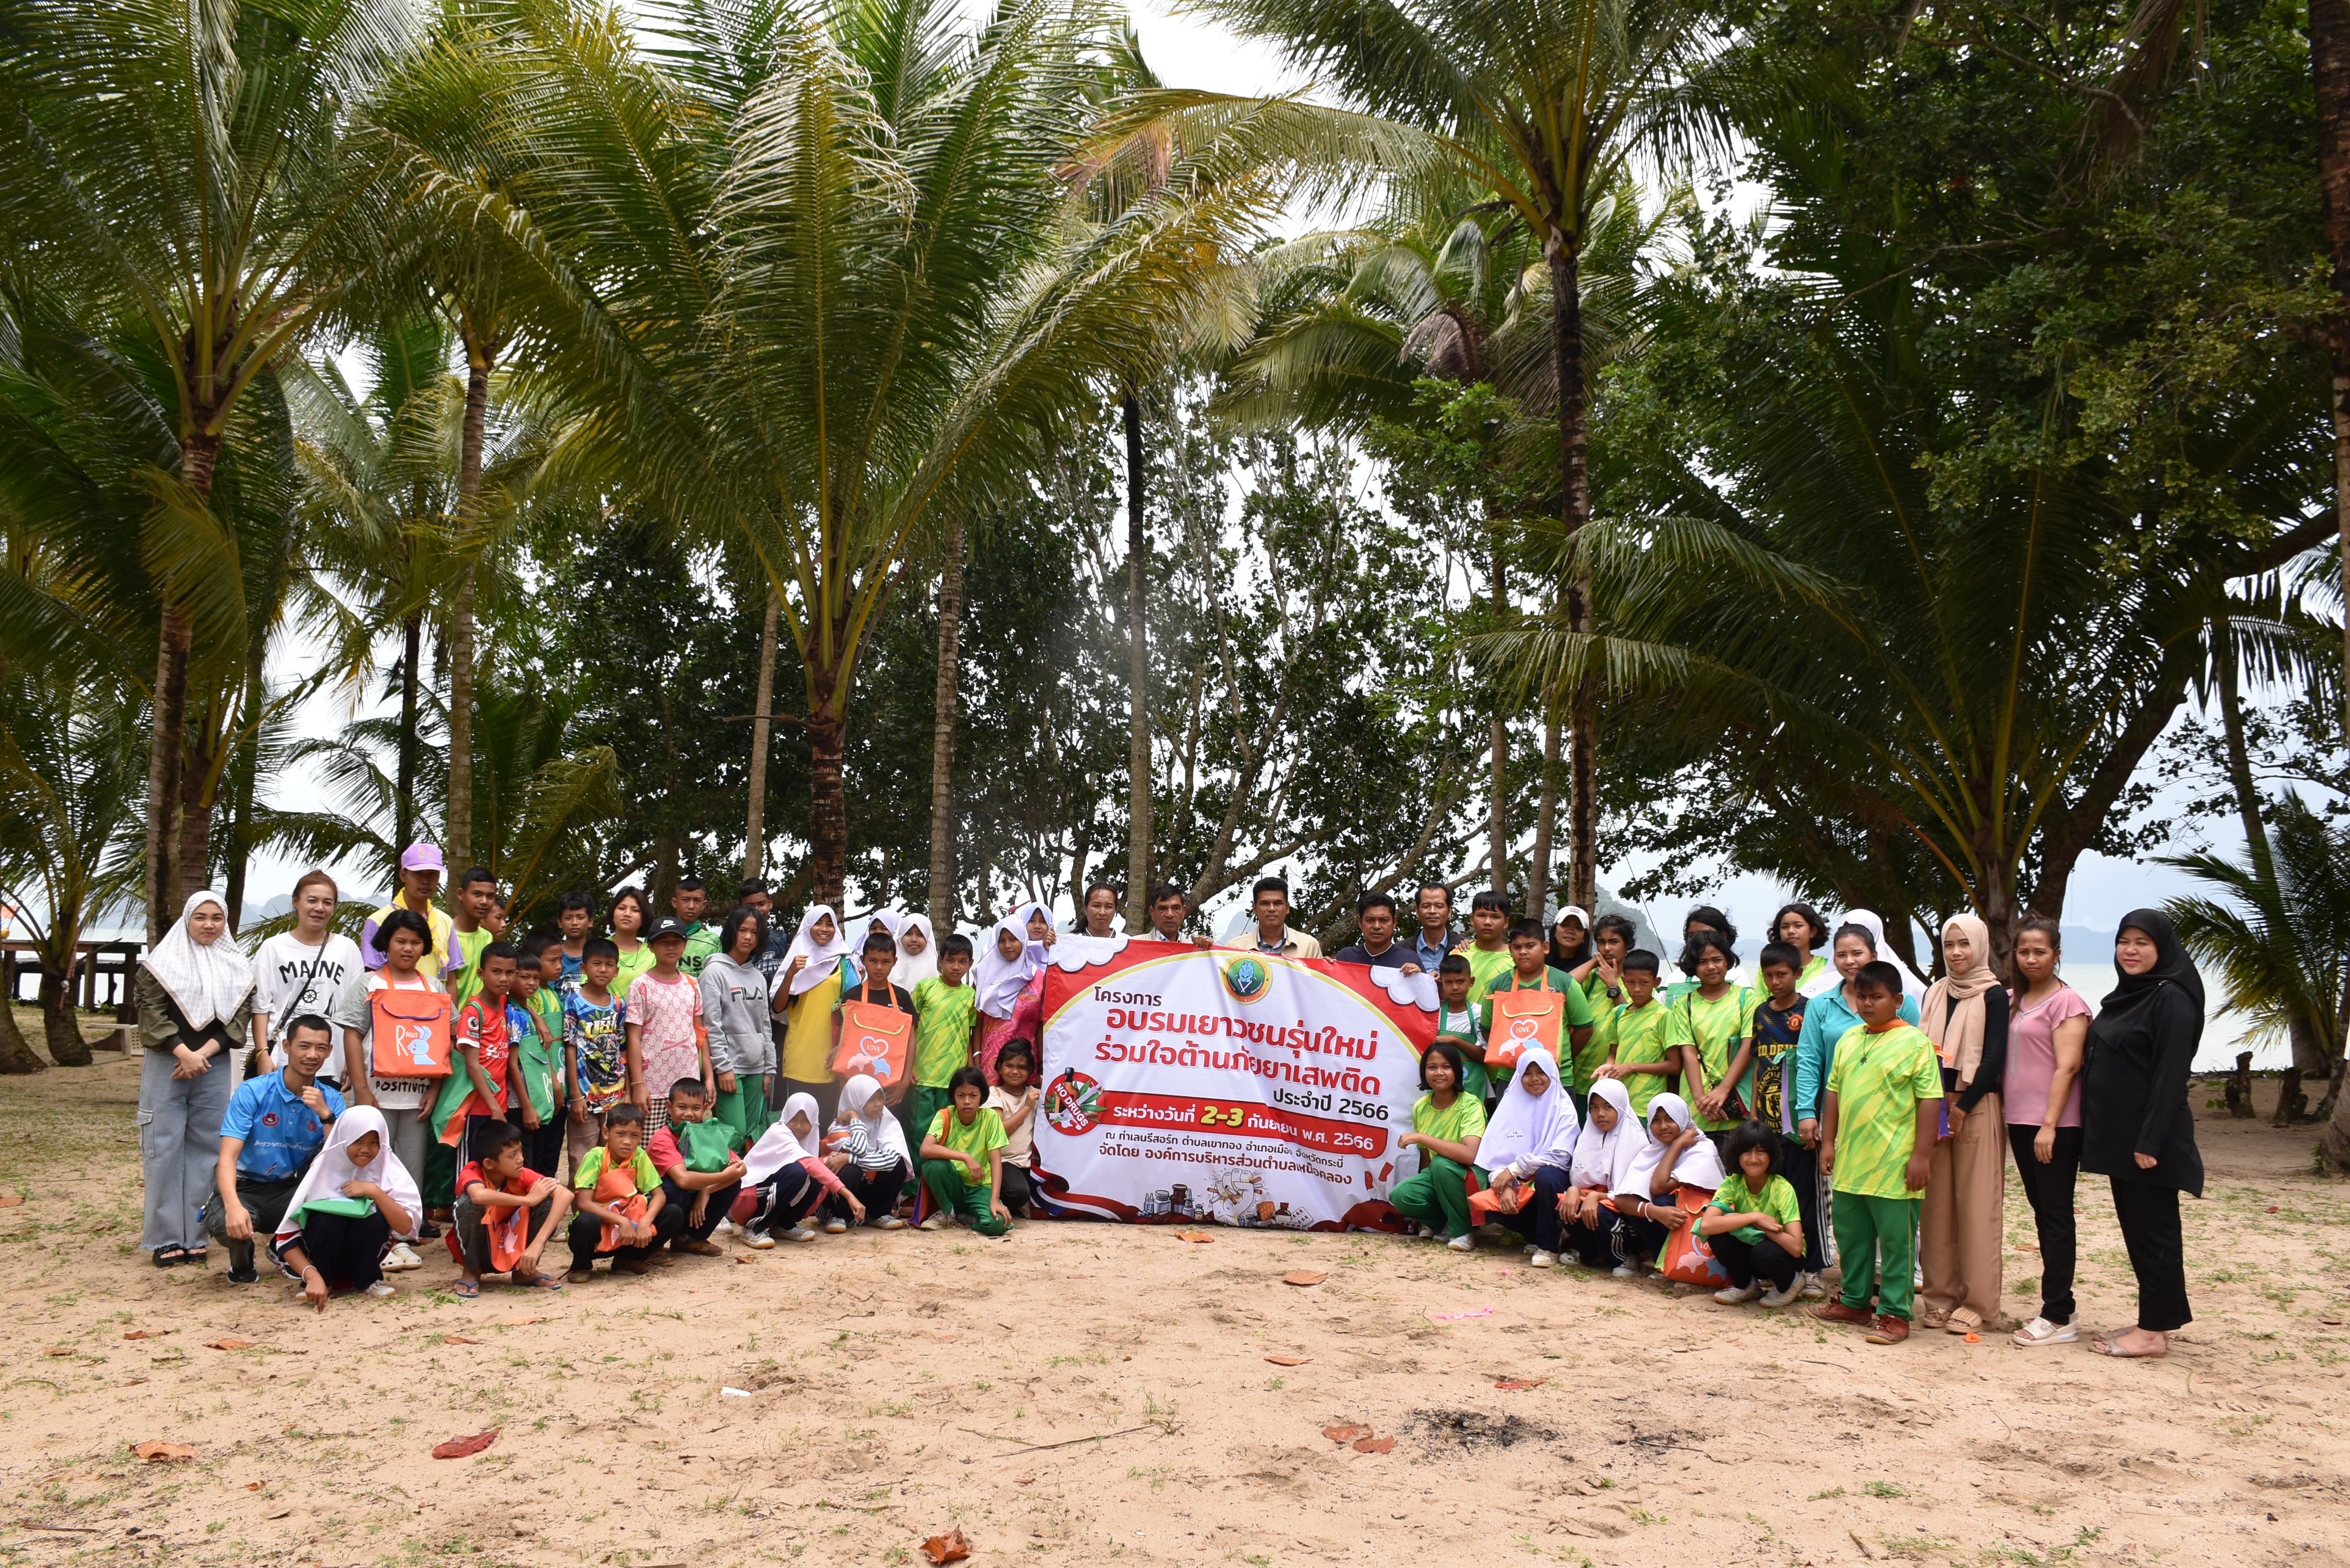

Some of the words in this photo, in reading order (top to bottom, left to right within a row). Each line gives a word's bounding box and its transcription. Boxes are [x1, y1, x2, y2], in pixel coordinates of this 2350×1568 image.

[730, 986, 763, 1002] FILA
[1094, 986, 1162, 1007] โครงการ
[867, 1044, 881, 1053] LOVE
[1107, 1008, 1378, 1060] อบรมเยาวชนรุ่นใหม่
[1095, 1034, 1380, 1096] ร่วมใจต้านภัยยาเสพติด
[1055, 1083, 1067, 1098] NO
[1064, 1097, 1088, 1127] DRUGS
[1273, 1088, 1332, 1112] ประจำปี
[1339, 1098, 1389, 1121] 2566
[1113, 1103, 1196, 1123] ระหว่างวันที่
[1201, 1105, 1243, 1126] 2-3
[1248, 1113, 1297, 1136] กันยายน
[1302, 1129, 1328, 1144] พ.ศ.
[1333, 1132, 1374, 1150] 2566
[1099, 1142, 1139, 1157] จัดโดย
[1145, 1147, 1352, 1184] องค์การบริหารส่วนตำบลเหนือคลอง
[1119, 1131, 1178, 1145] ท่าเลนรีสอร์ท
[1182, 1135, 1242, 1150] ตำบลเขาทอง
[1246, 1141, 1293, 1155] อำเภอเมือง
[1295, 1148, 1344, 1168] จังหวัดกระบี่
